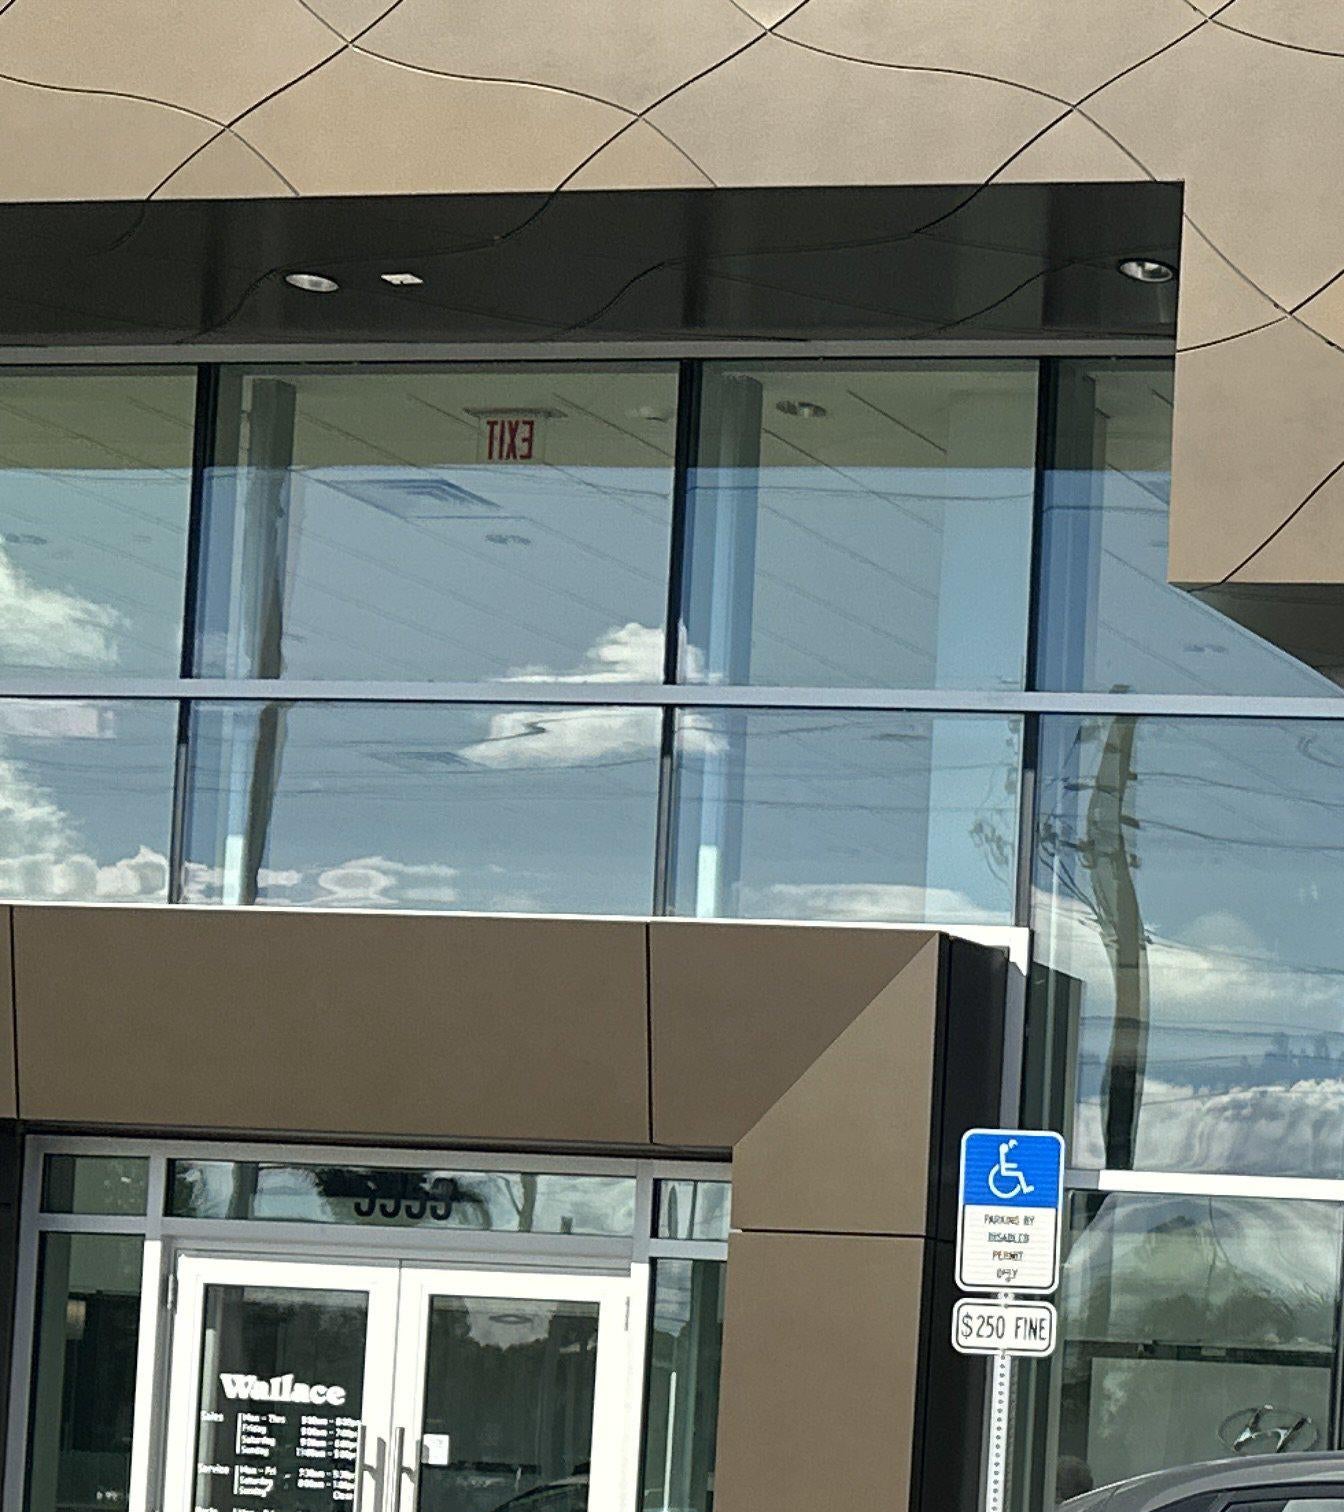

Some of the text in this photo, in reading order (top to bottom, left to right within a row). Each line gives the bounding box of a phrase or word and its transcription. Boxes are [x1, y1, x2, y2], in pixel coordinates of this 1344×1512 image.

[984, 1214, 1034, 1225] PARKING BY
[987, 1232, 1030, 1243] DISABLED
[992, 1250, 1023, 1260] PERMIT
[961, 1312, 1047, 1340] $250 FINE
[220, 1373, 346, 1405] Wallace
